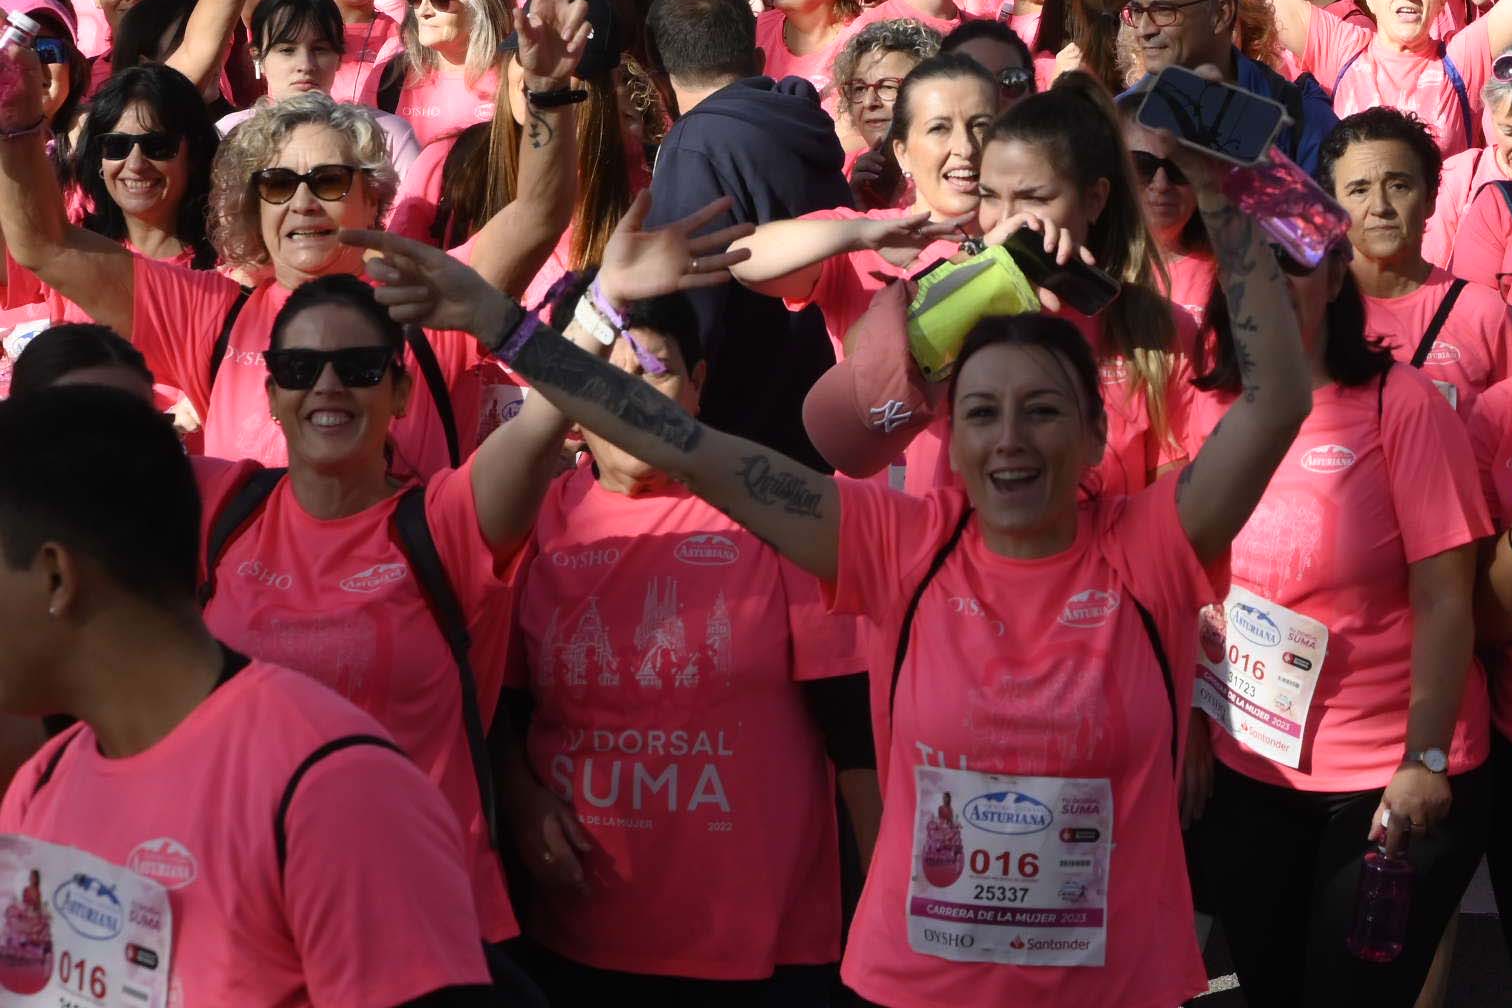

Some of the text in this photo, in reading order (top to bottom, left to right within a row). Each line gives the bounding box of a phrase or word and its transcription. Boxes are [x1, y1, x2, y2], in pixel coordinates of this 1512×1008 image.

[1228, 644, 1266, 680] 016
[1236, 696, 1246, 709] LA
[1245, 702, 1271, 724] MUJER
[592, 729, 735, 758] DORSAL
[550, 754, 733, 814] SUMA
[969, 804, 1046, 826] ASTURIANA
[1061, 804, 1100, 815] SUMA
[969, 849, 1040, 879] 016
[973, 884, 1030, 904] 25337
[926, 904, 976, 920] CARRERA
[977, 910, 996, 922] DE
[997, 911, 1013, 922] LA
[1014, 913, 1058, 924] MUJER
[924, 928, 975, 949] OYSHO
[1027, 938, 1091, 953] Santander
[60, 950, 107, 1000] 016
